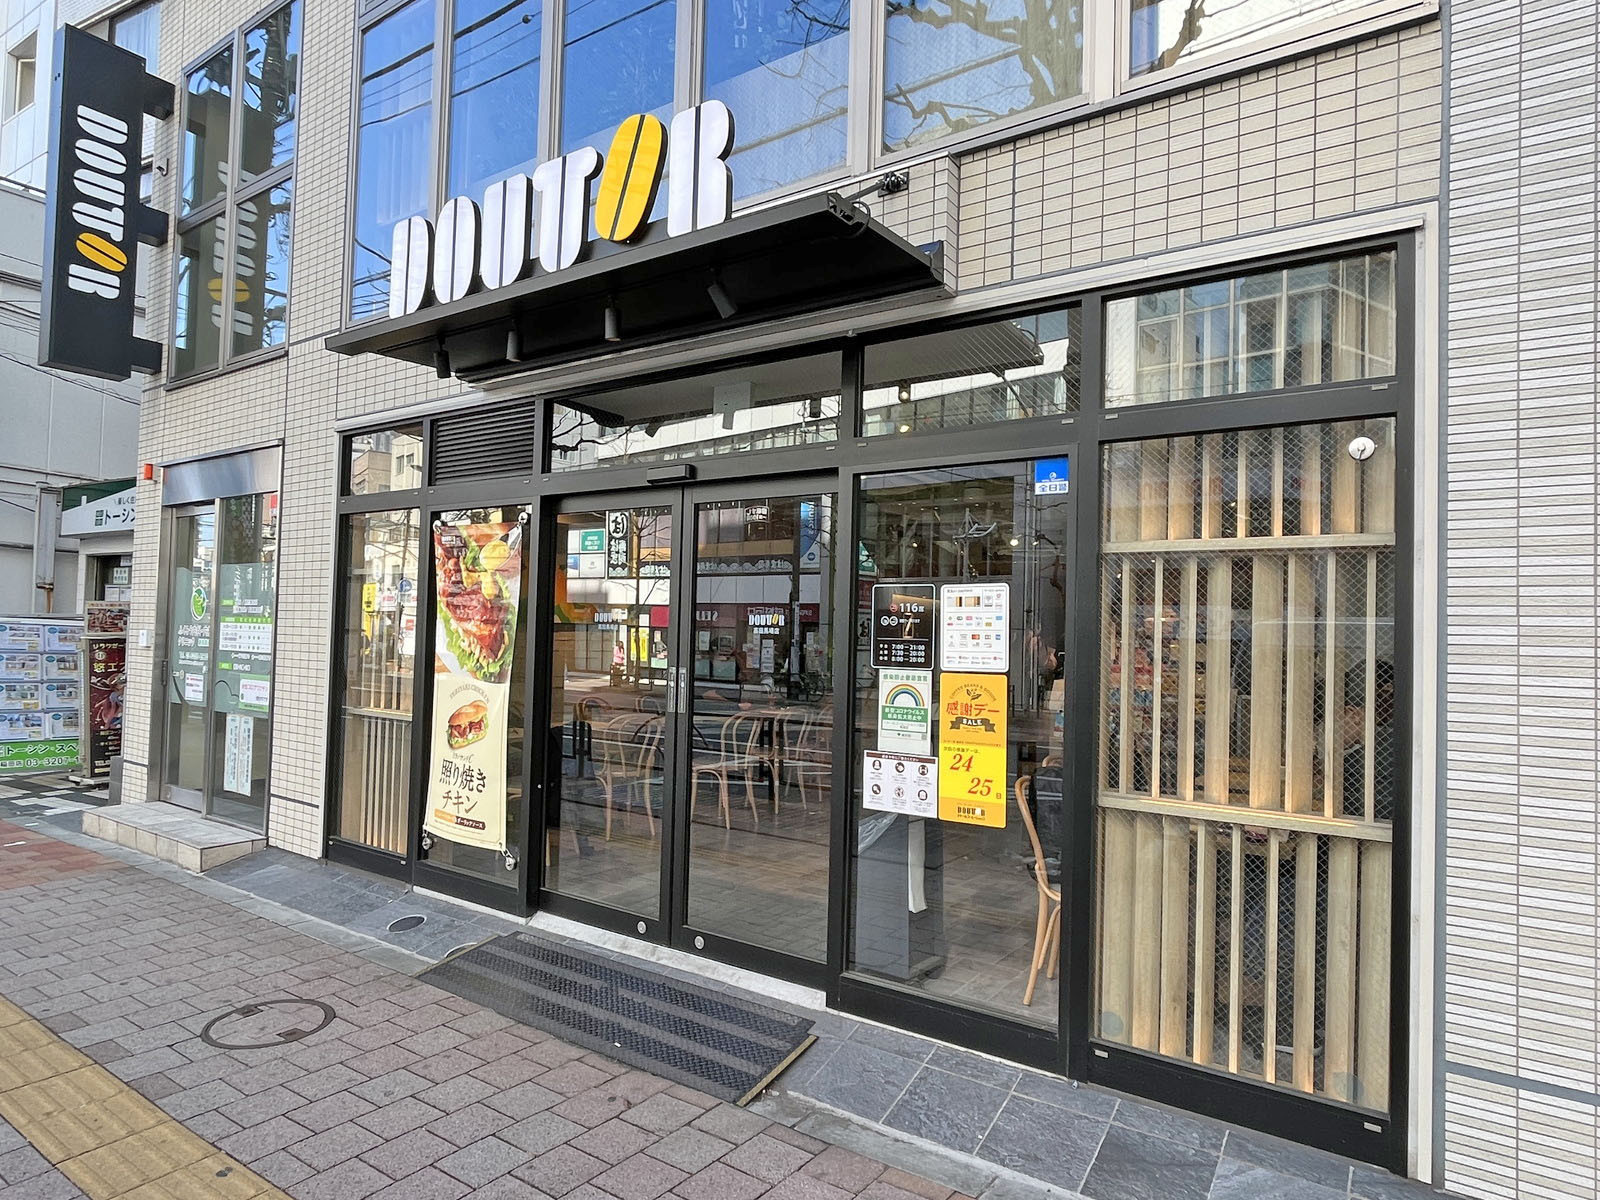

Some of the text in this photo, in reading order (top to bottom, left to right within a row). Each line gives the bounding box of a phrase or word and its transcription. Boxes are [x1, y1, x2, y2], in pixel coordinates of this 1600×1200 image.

[68, 104, 128, 299] DOUTOR
[389, 99, 735, 319] DOUTOR
[748, 613, 785, 626] DOUTOR
[946, 700, 1000, 716] 感謝デー
[962, 718, 983, 726] SALE
[950, 753, 973, 771] 24
[440, 759, 487, 794] 照り焼き
[968, 777, 993, 796] 25
[442, 790, 478, 814] チキン
